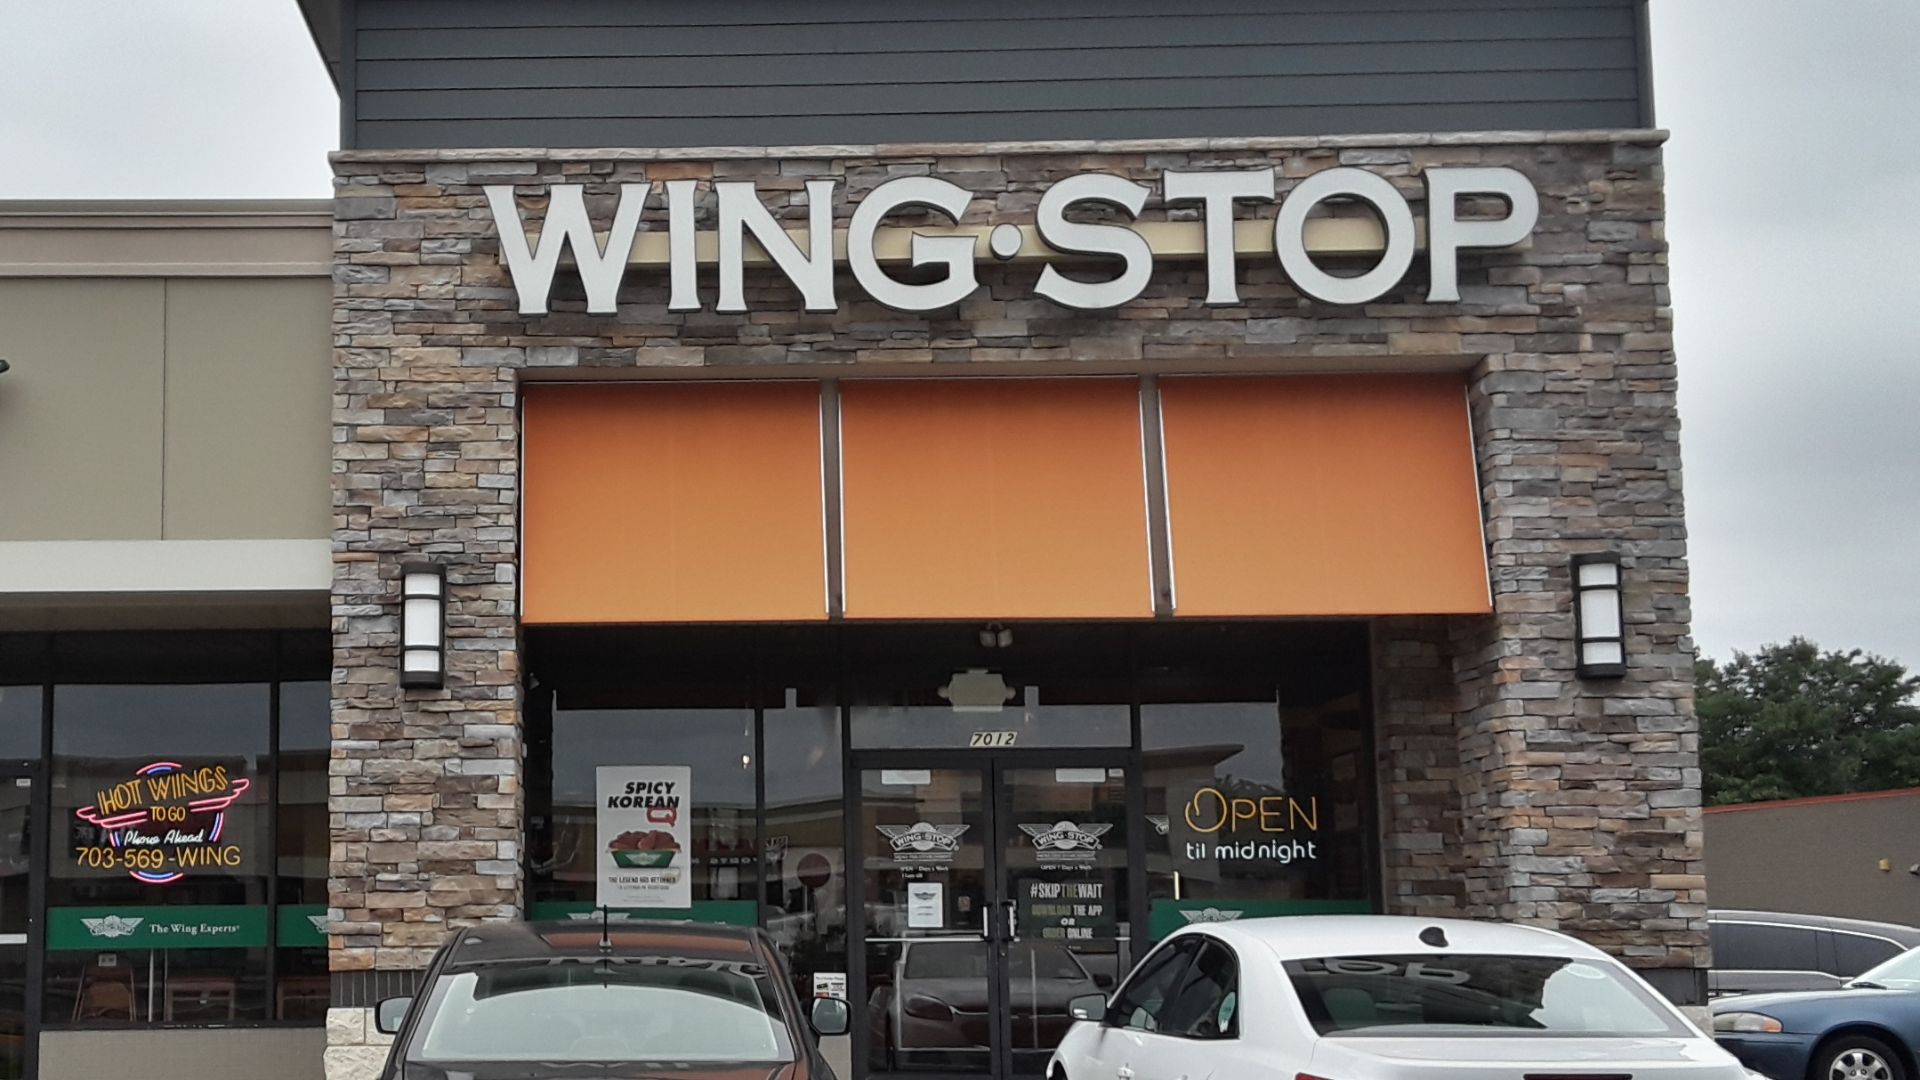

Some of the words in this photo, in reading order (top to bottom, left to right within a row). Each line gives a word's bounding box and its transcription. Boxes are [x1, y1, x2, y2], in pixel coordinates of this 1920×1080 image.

[971, 733, 1015, 746] 7012
[97, 779, 143, 815] HOT
[147, 765, 229, 802] WINGS
[624, 782, 676, 794] SPICY
[607, 796, 680, 808] KOREAN
[150, 806, 166, 821] TO
[168, 806, 186, 822] GO
[646, 805, 677, 828] Q
[1185, 787, 1318, 833] OPEN
[163, 829, 204, 845] Ahead
[1186, 842, 1206, 860] til
[1215, 839, 1317, 864] midnight
[1073, 904, 1086, 916] THE
[1088, 904, 1102, 916] APP
[1060, 917, 1075, 926] OR
[149, 923, 169, 934] The
[170, 923, 197, 936] Wing
[1067, 927, 1093, 939] ONLINE
